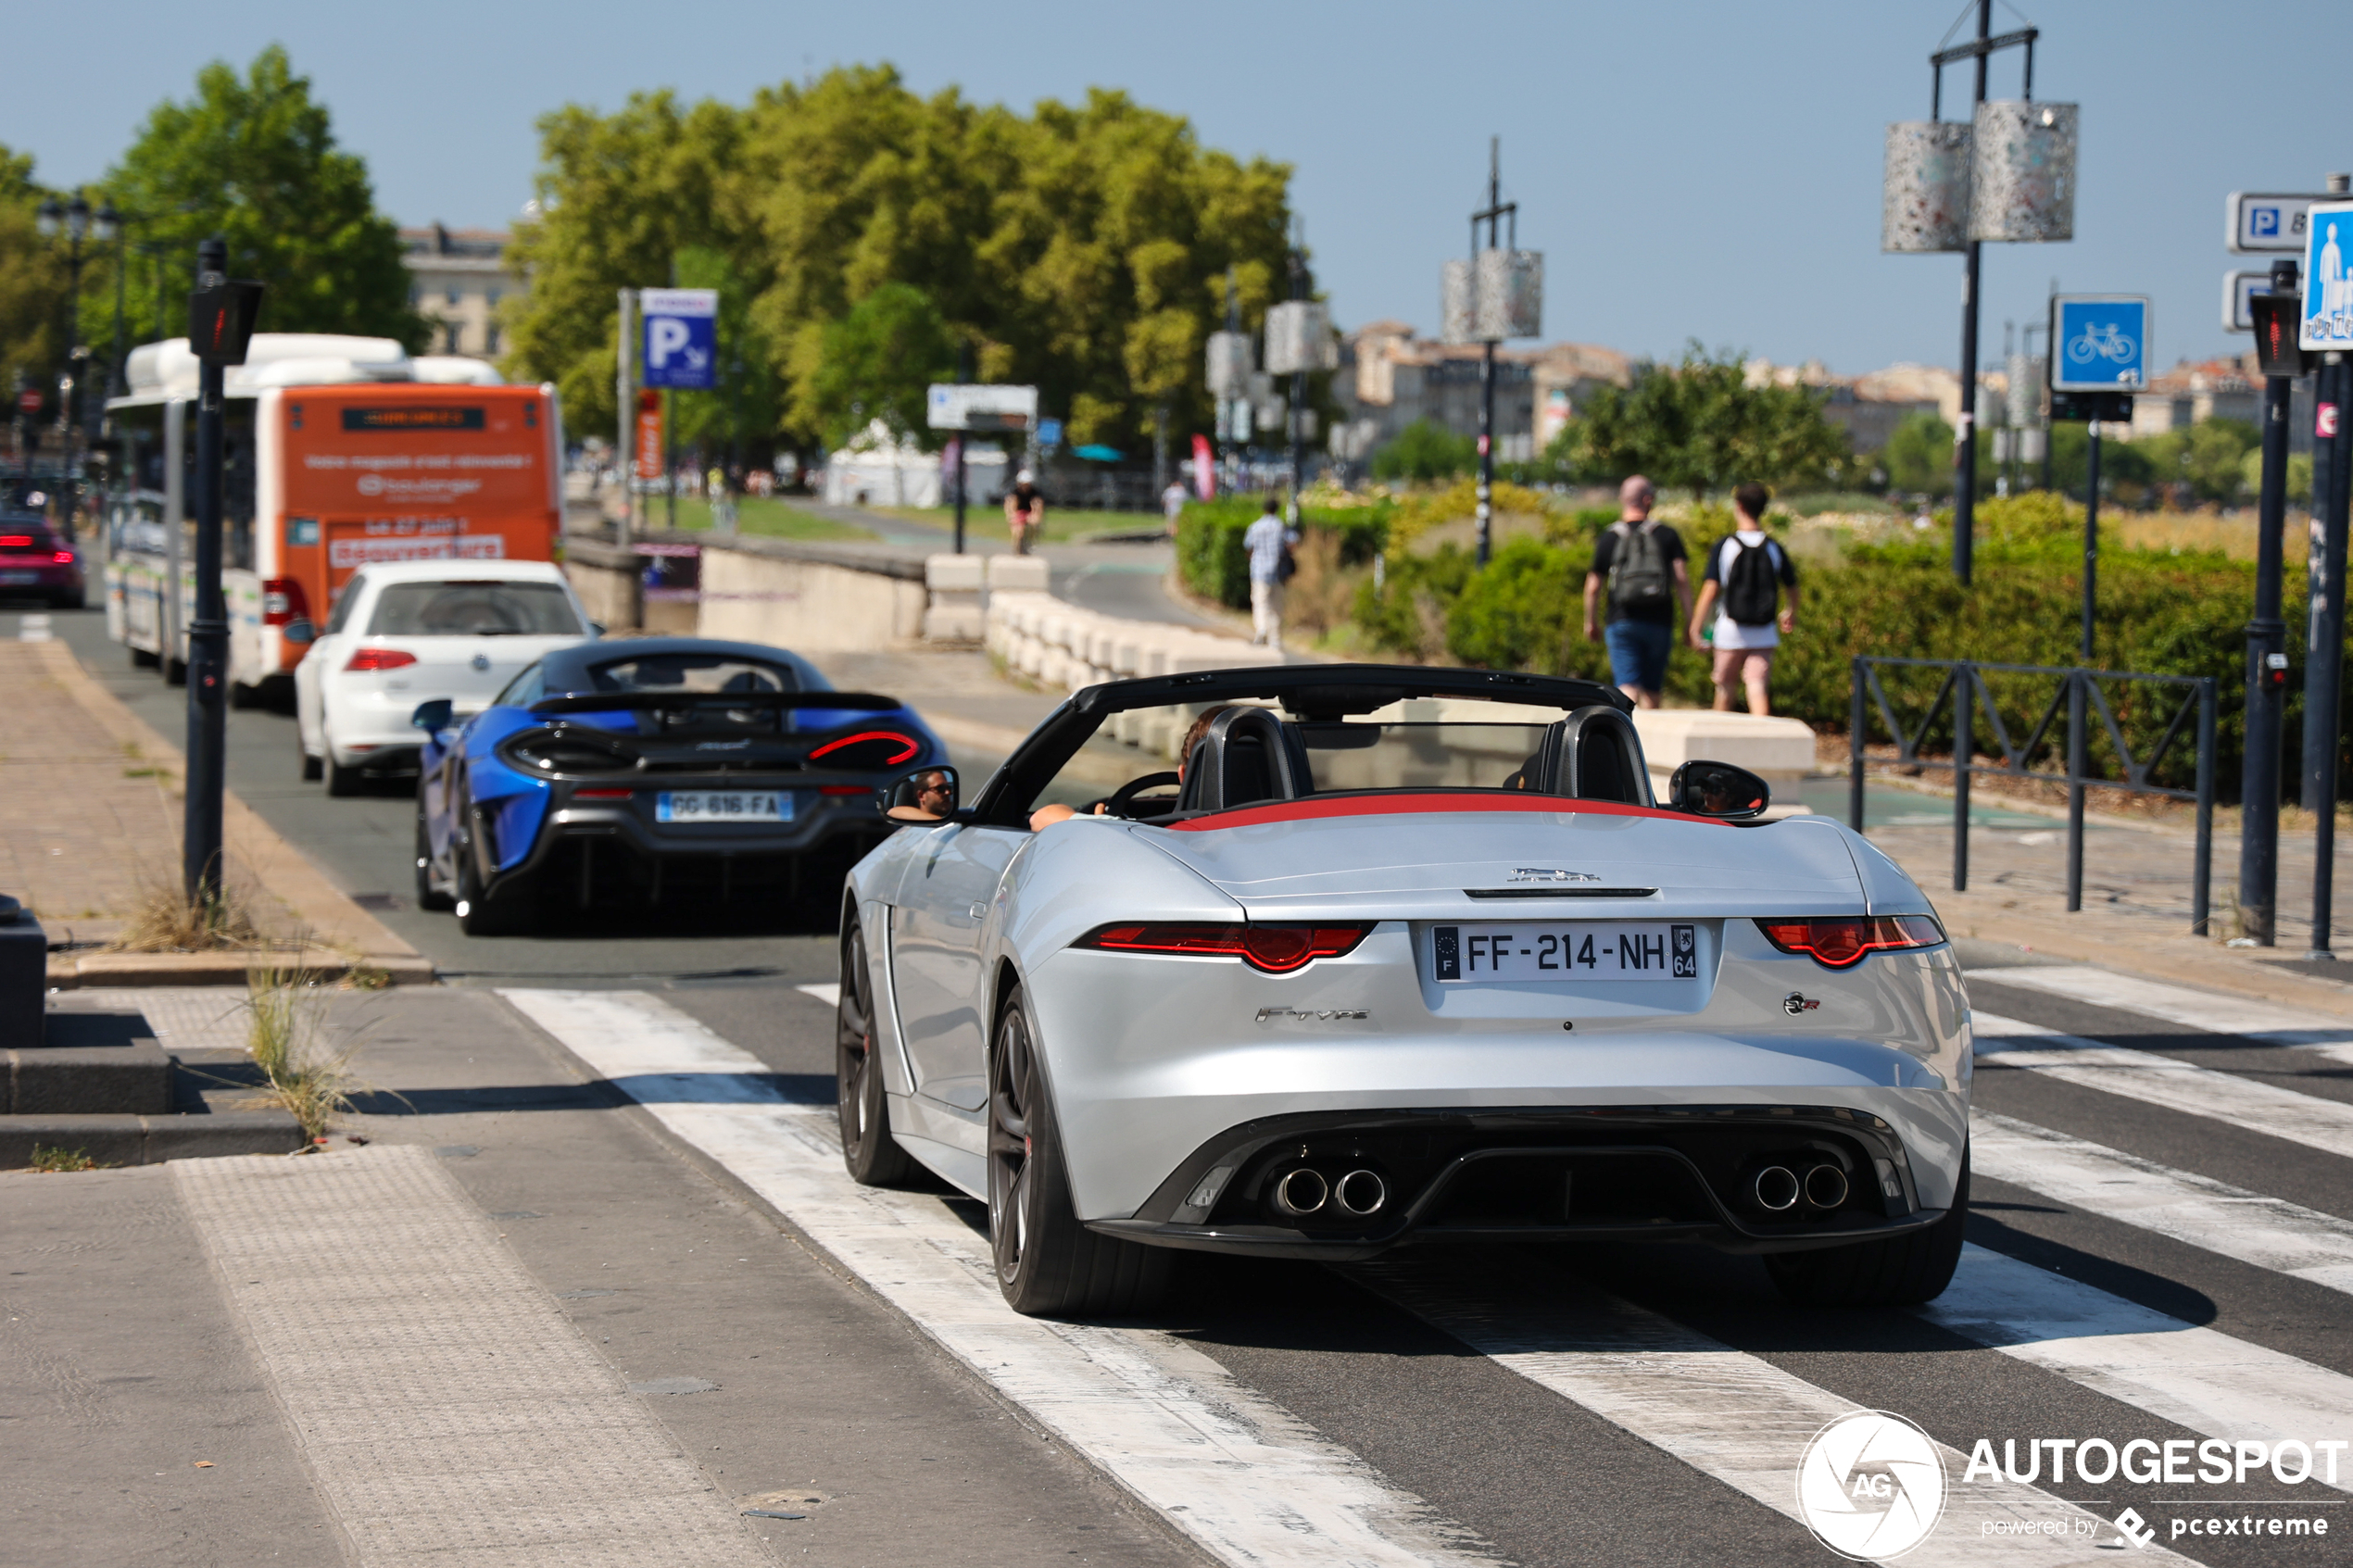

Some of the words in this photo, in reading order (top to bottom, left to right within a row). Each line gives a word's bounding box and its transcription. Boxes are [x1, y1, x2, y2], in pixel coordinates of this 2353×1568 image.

[648, 317, 690, 369] P
[1442, 960, 1453, 971] F
[1467, 934, 1665, 972] FF-214-NH
[1673, 955, 1695, 975] 64
